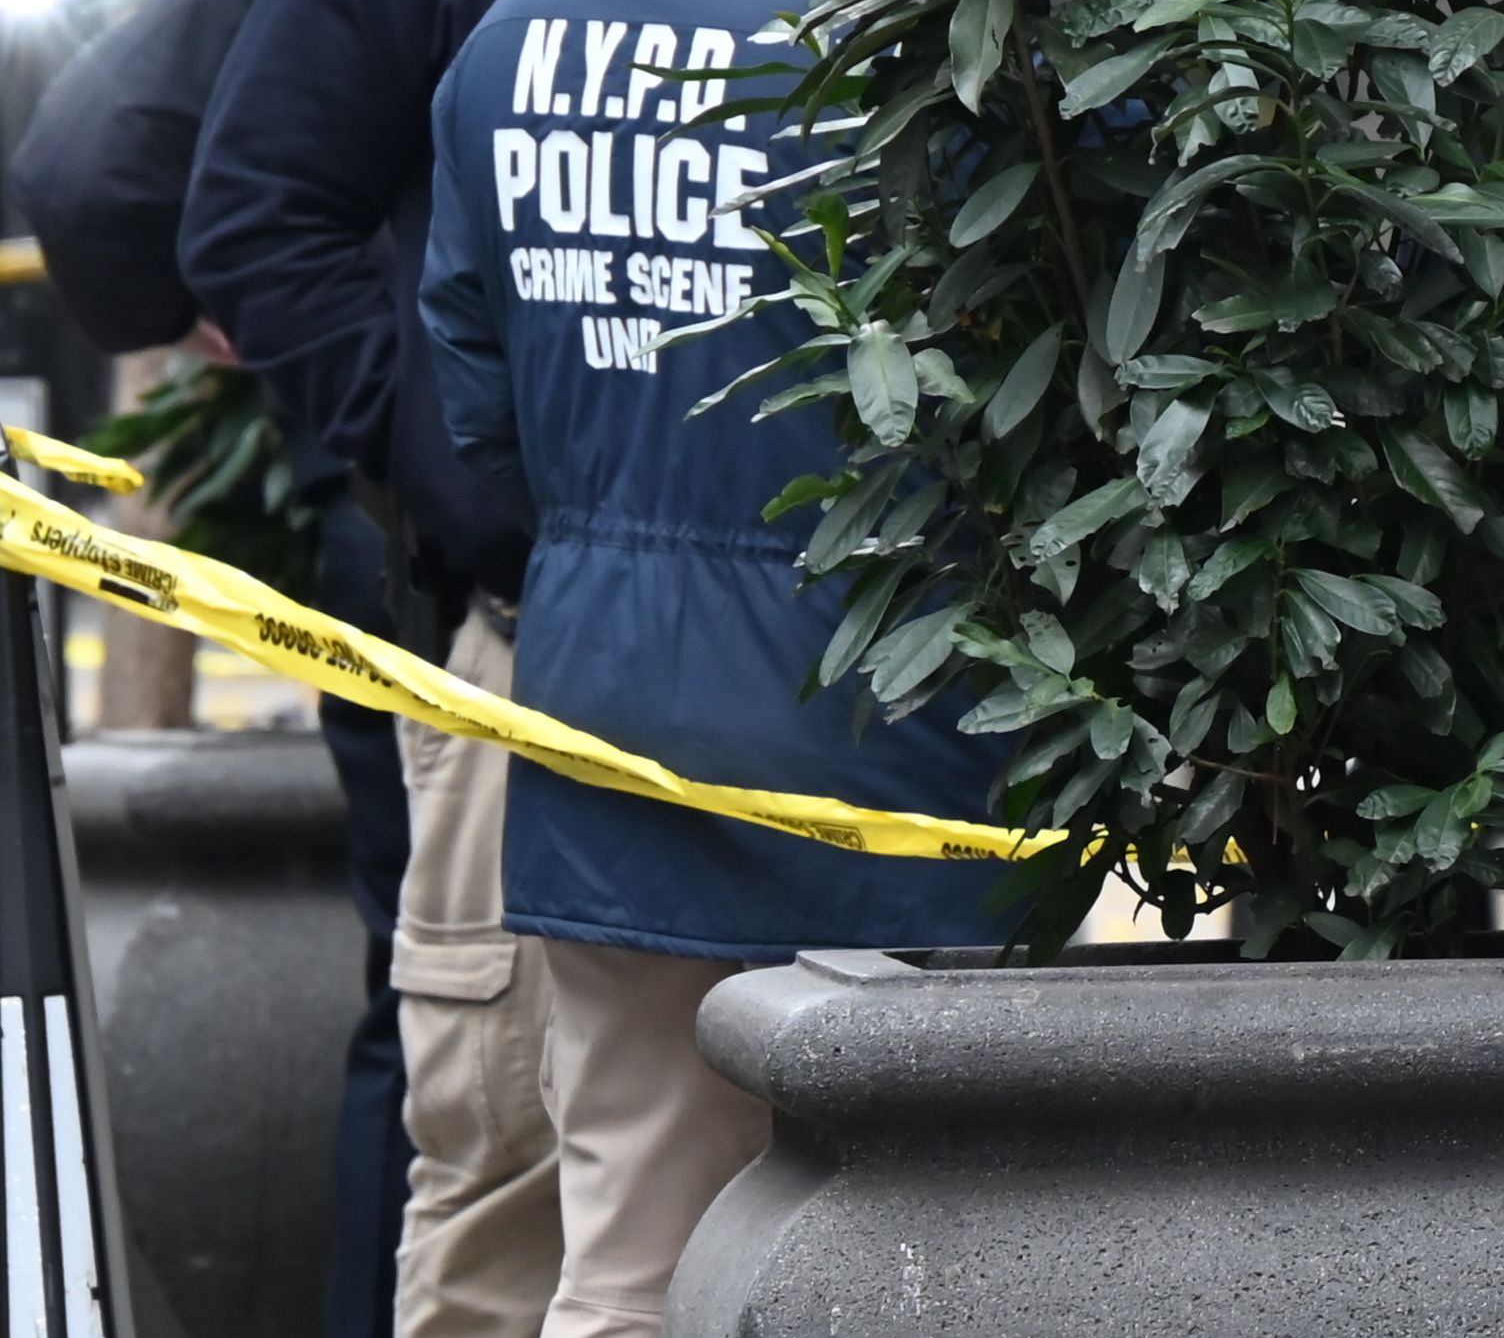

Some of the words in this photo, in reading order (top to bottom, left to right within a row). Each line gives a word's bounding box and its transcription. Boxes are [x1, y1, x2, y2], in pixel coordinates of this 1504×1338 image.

[513, 19, 746, 131] N.Y.P.D.
[494, 129, 769, 250] POLICE
[510, 249, 616, 304] CRIME
[626, 255, 753, 317] SCENE
[583, 317, 661, 373] UNIT
